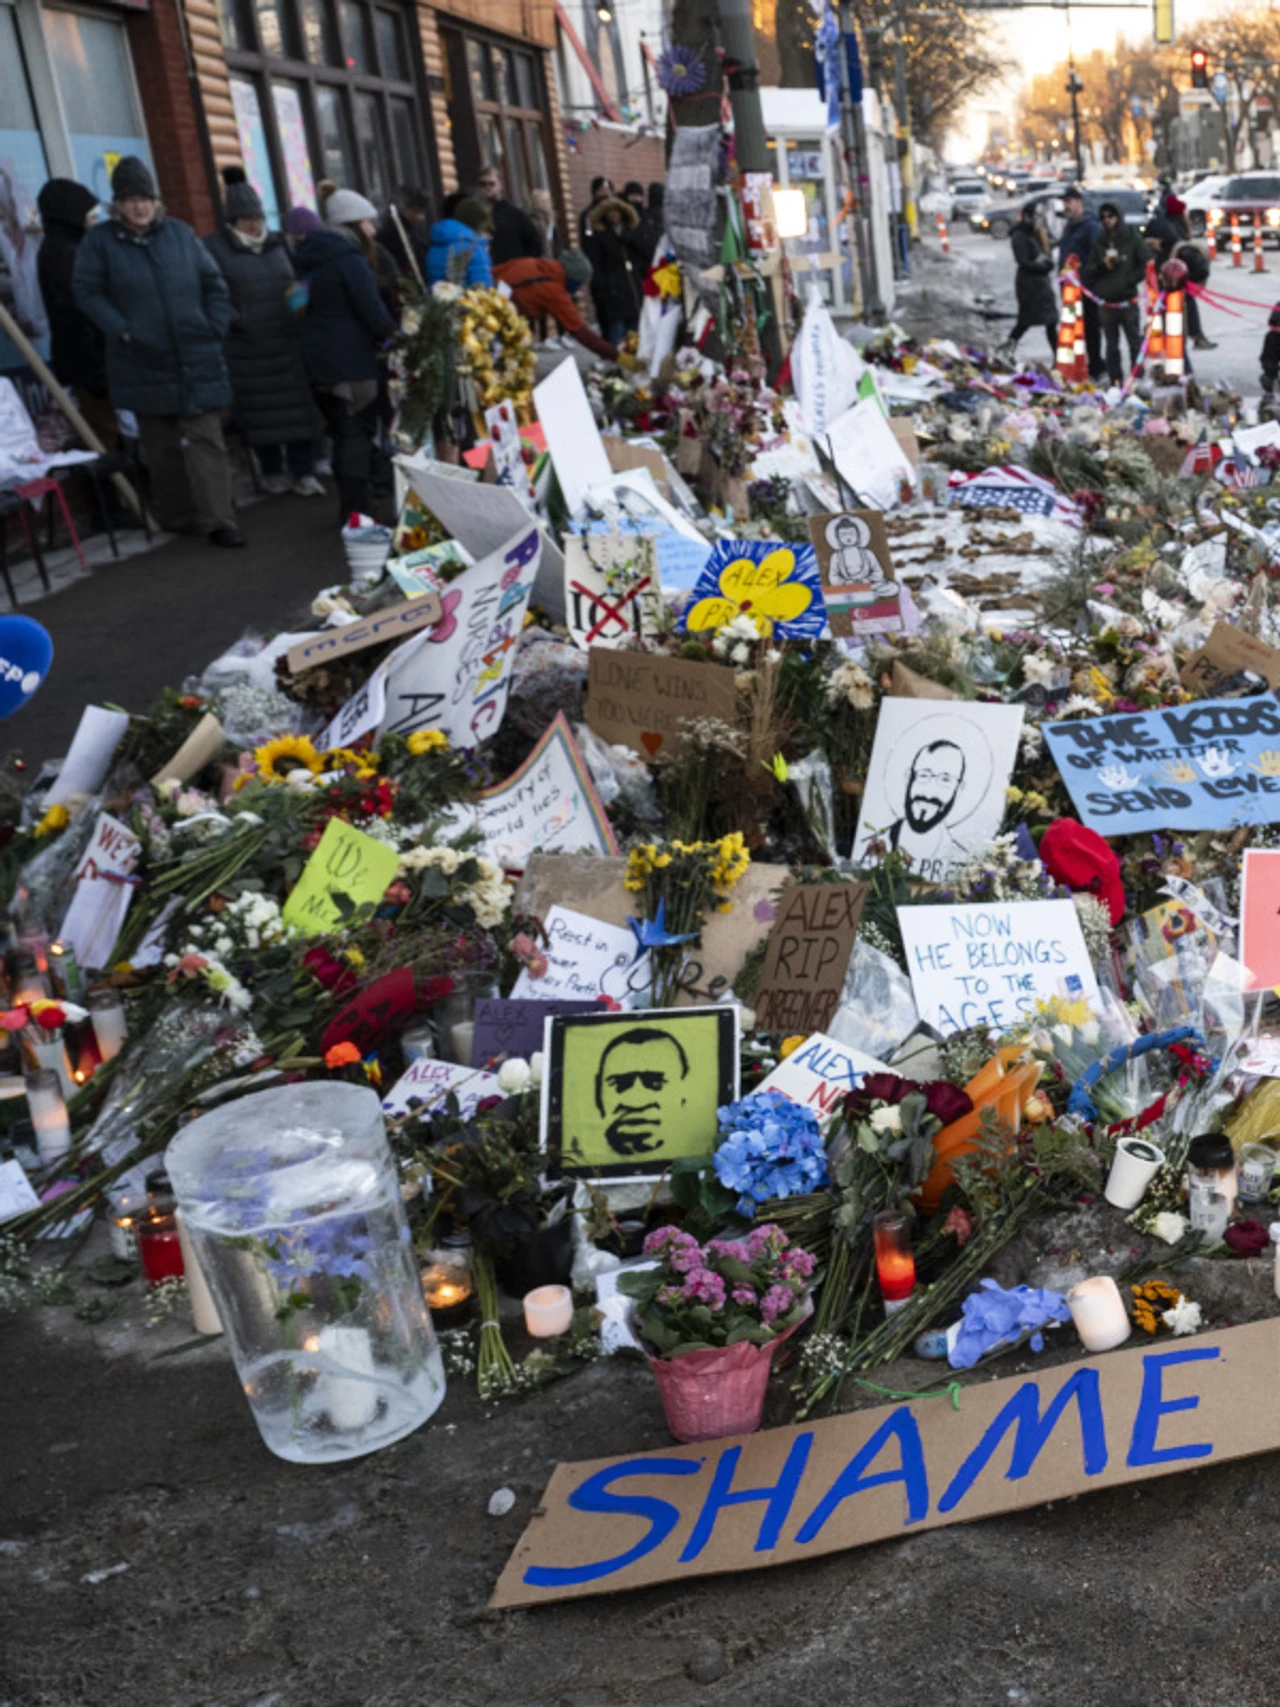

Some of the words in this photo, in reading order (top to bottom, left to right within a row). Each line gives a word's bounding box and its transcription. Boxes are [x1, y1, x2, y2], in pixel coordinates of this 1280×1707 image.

[725, 566, 788, 588] ALEX
[1049, 715, 1160, 751] THE
[1066, 751, 1107, 770] OF
[1085, 786, 1193, 817] SEND
[777, 886, 867, 937] ALEX
[950, 912, 1011, 940] NOW
[550, 917, 593, 947] Rest
[595, 942, 609, 952] in
[773, 936, 841, 982] RIP
[915, 942, 954, 972] HE
[966, 938, 1069, 971] BELONGS
[954, 976, 990, 996] TO
[1001, 972, 1038, 993] THE
[403, 1064, 456, 1083] ALEX
[793, 1042, 869, 1091] ALEX
[524, 1347, 1221, 1587] SHAME
